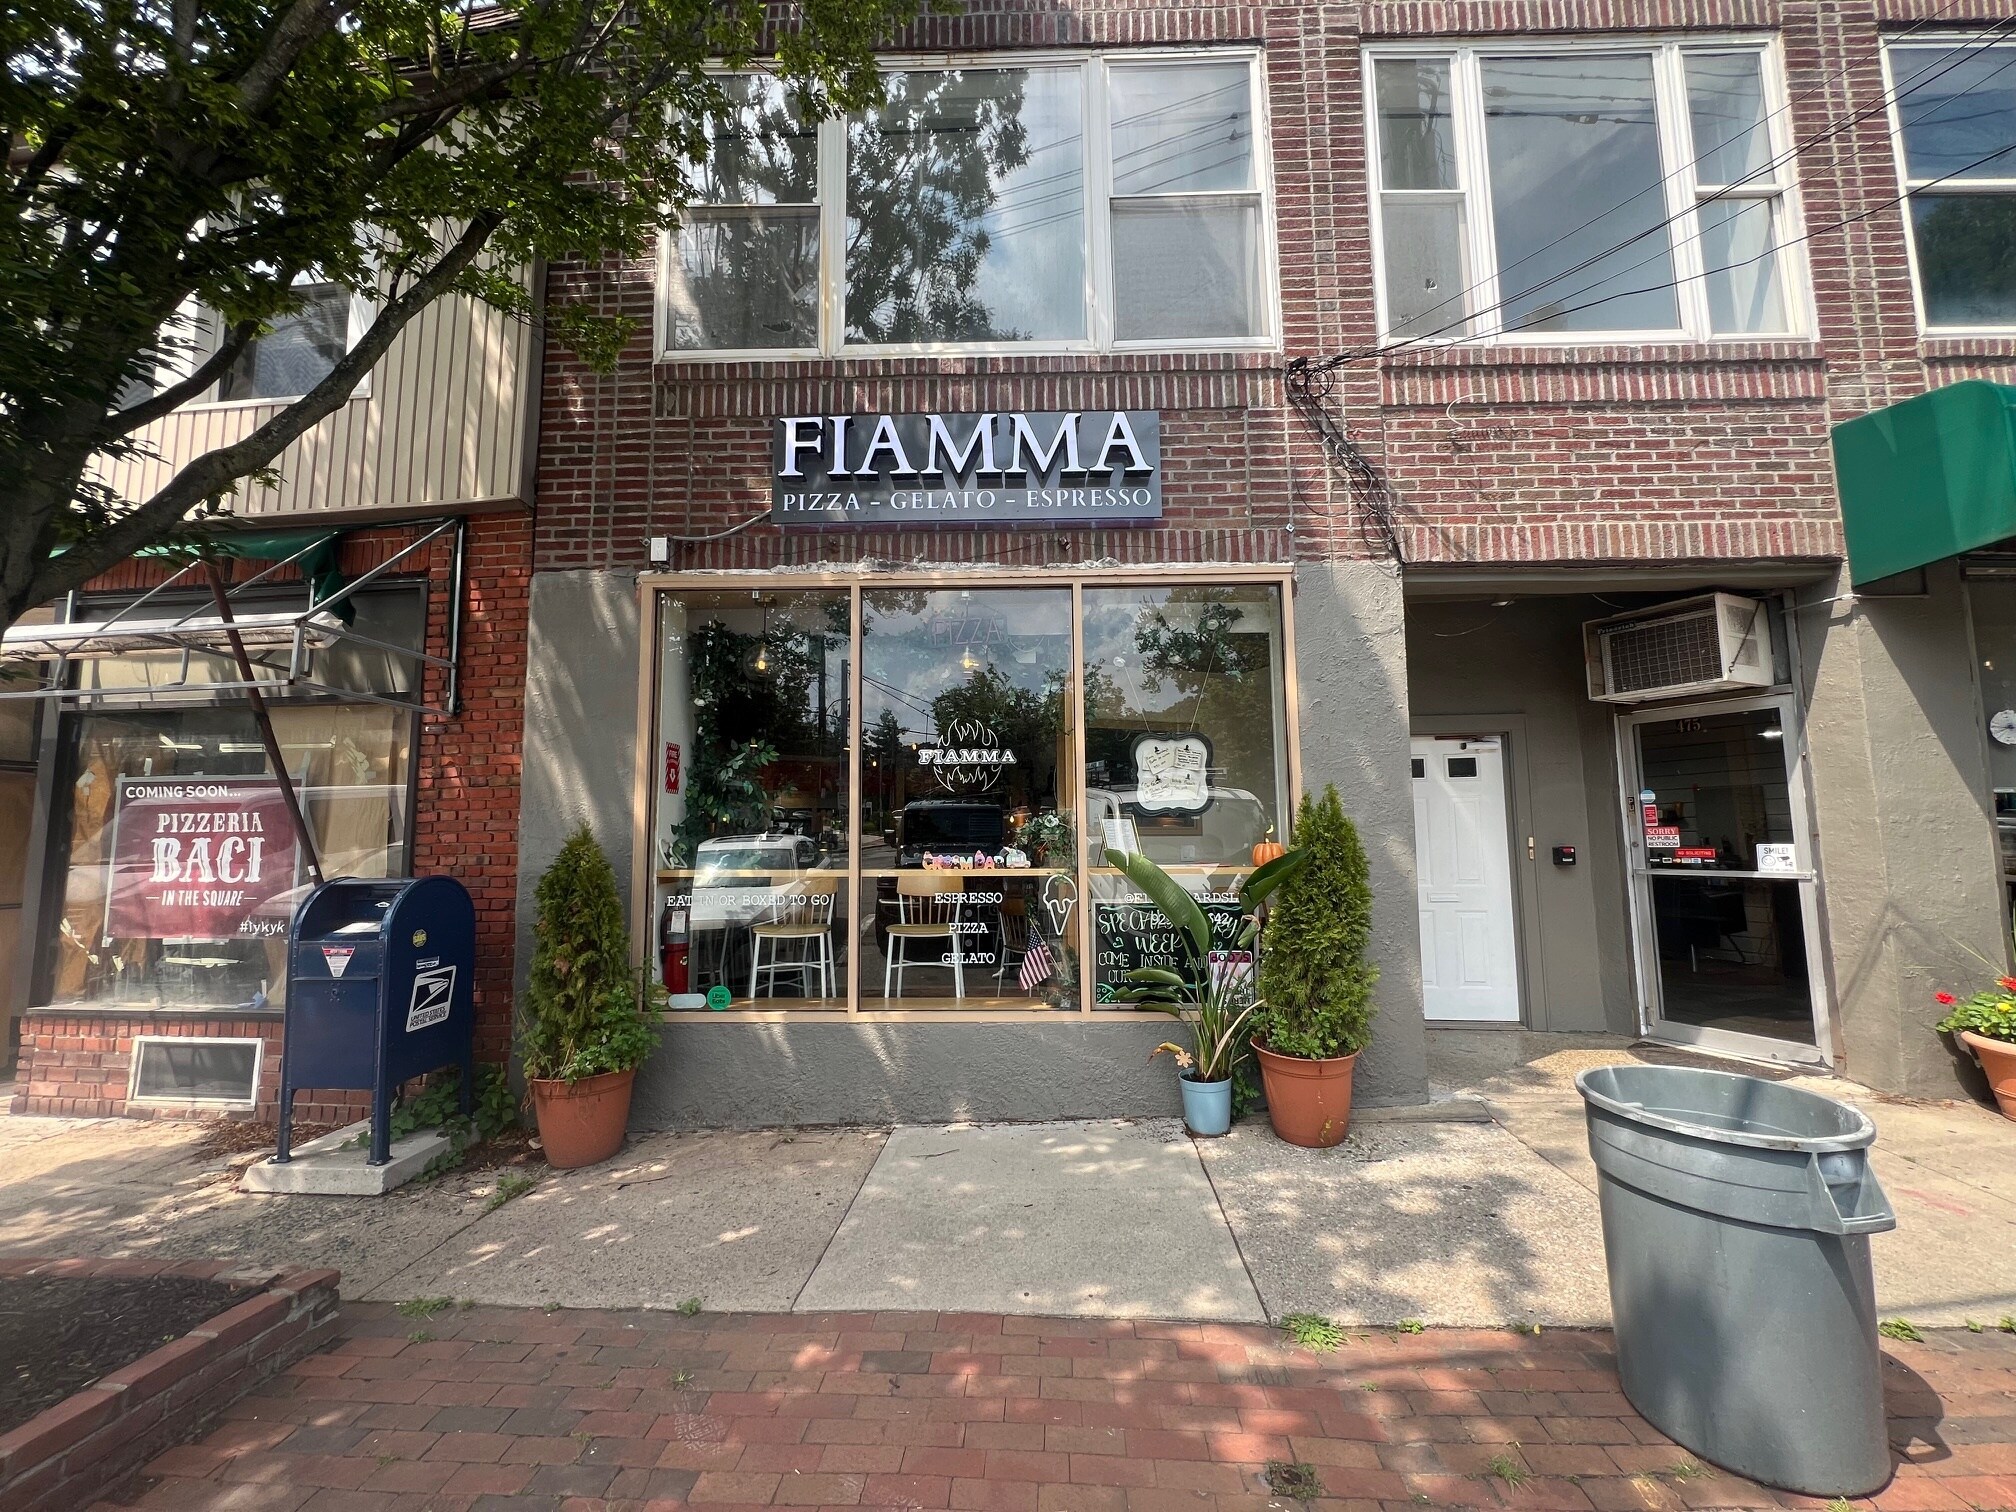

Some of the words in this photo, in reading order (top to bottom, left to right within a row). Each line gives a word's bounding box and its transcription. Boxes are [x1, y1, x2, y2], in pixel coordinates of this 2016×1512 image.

[777, 411, 1155, 478] FIAMMA
[783, 493, 861, 512] PIZZA
[890, 490, 997, 511] GELATO
[1026, 487, 1152, 508] ESPRESSO
[933, 616, 1003, 646] PIZZA
[1677, 718, 1701, 733] 475
[918, 748, 1017, 765] FIAMMA
[125, 785, 183, 798] COMING
[185, 785, 241, 798] SOON...
[156, 812, 264, 833] PIZZERIA
[149, 836, 266, 884] BACI
[161, 890, 176, 906] IN
[178, 890, 200, 906] THE
[202, 890, 245, 907] SQUARE
[666, 895, 692, 907] EAT
[700, 895, 714, 906] IN
[719, 895, 736, 906] OR
[742, 894, 786, 906] BOXED
[789, 894, 807, 906] TO
[810, 894, 830, 906] GO
[934, 892, 1003, 904] ESPRESSO
[948, 922, 989, 934] PIZZA
[1134, 932, 1184, 954] WEEK
[941, 952, 996, 964] GELATO
[1098, 950, 1130, 968] COME
[409, 1018, 428, 1028] POSTAL
[429, 1010, 446, 1021] SERVICE
[410, 1010, 429, 1021] UNITED
[430, 1006, 446, 1016] STATES
